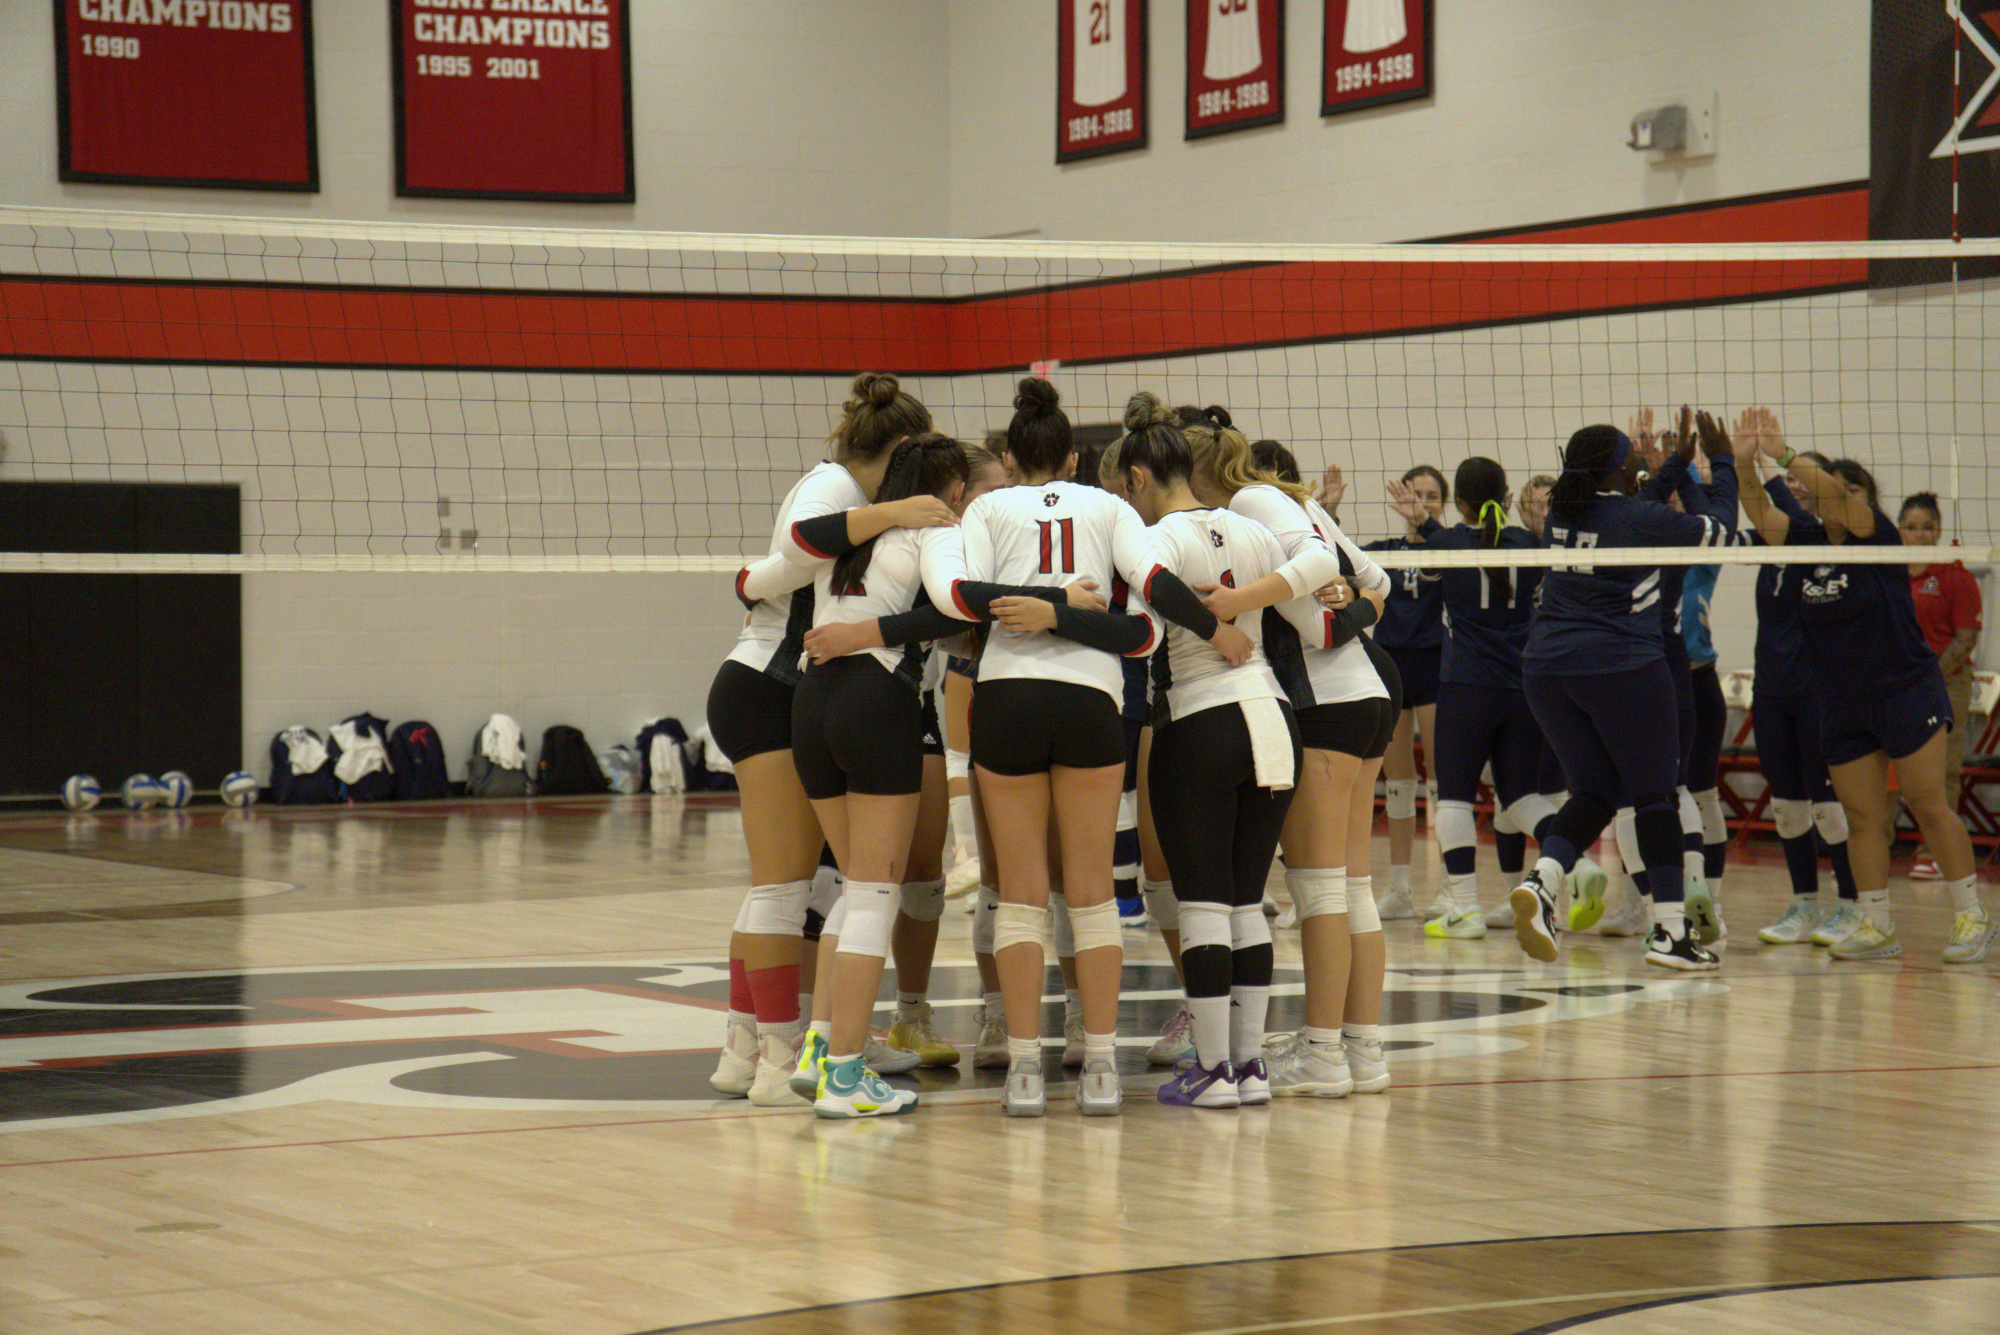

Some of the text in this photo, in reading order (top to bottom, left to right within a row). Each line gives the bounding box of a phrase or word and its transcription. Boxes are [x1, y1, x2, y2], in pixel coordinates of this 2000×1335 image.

[79, 0, 292, 32] CHAMPIONS
[414, 12, 610, 49] CHAMPIONS
[1089, 0, 1111, 45] 21
[81, 33, 140, 59] 1990
[416, 53, 540, 80] 1995 2001
[1335, 52, 1415, 93] 1994-1998
[1034, 516, 1075, 574] 11
